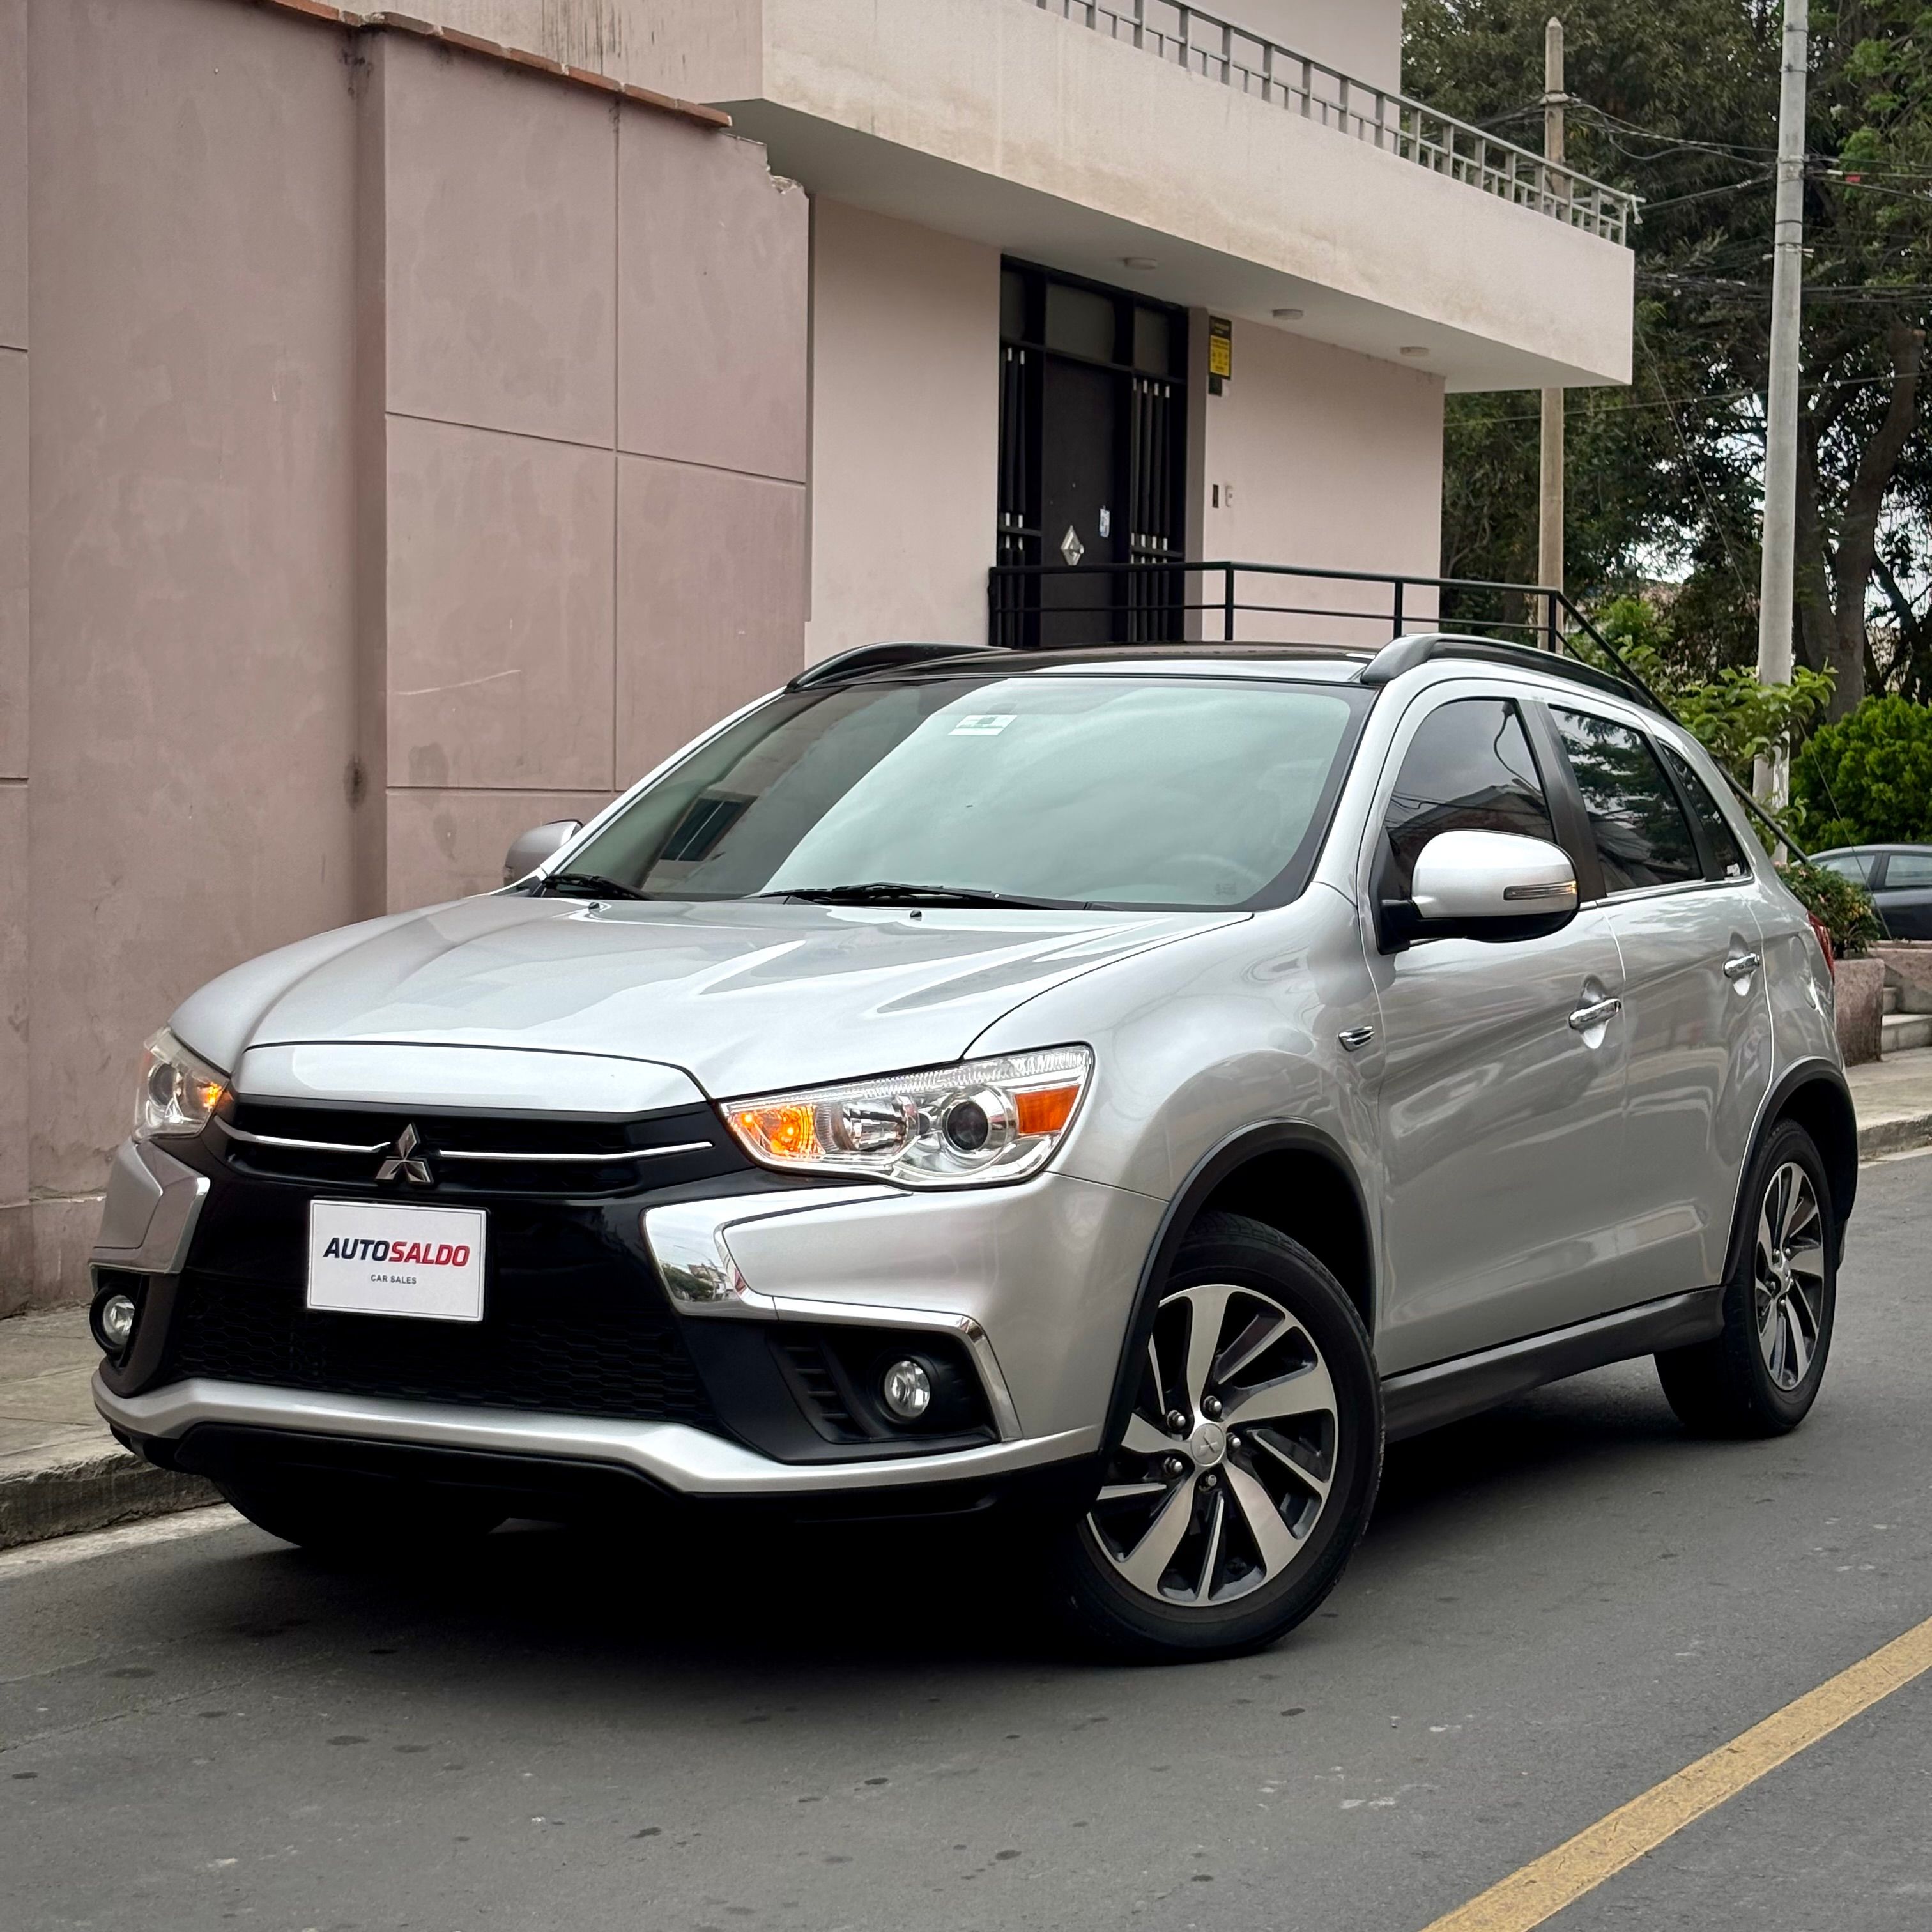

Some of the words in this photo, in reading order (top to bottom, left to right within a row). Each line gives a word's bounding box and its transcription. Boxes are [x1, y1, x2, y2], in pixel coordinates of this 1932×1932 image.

[323, 1238, 470, 1267] AUTOSALDO
[371, 1274, 388, 1283] CAR
[390, 1275, 417, 1285] SALES
